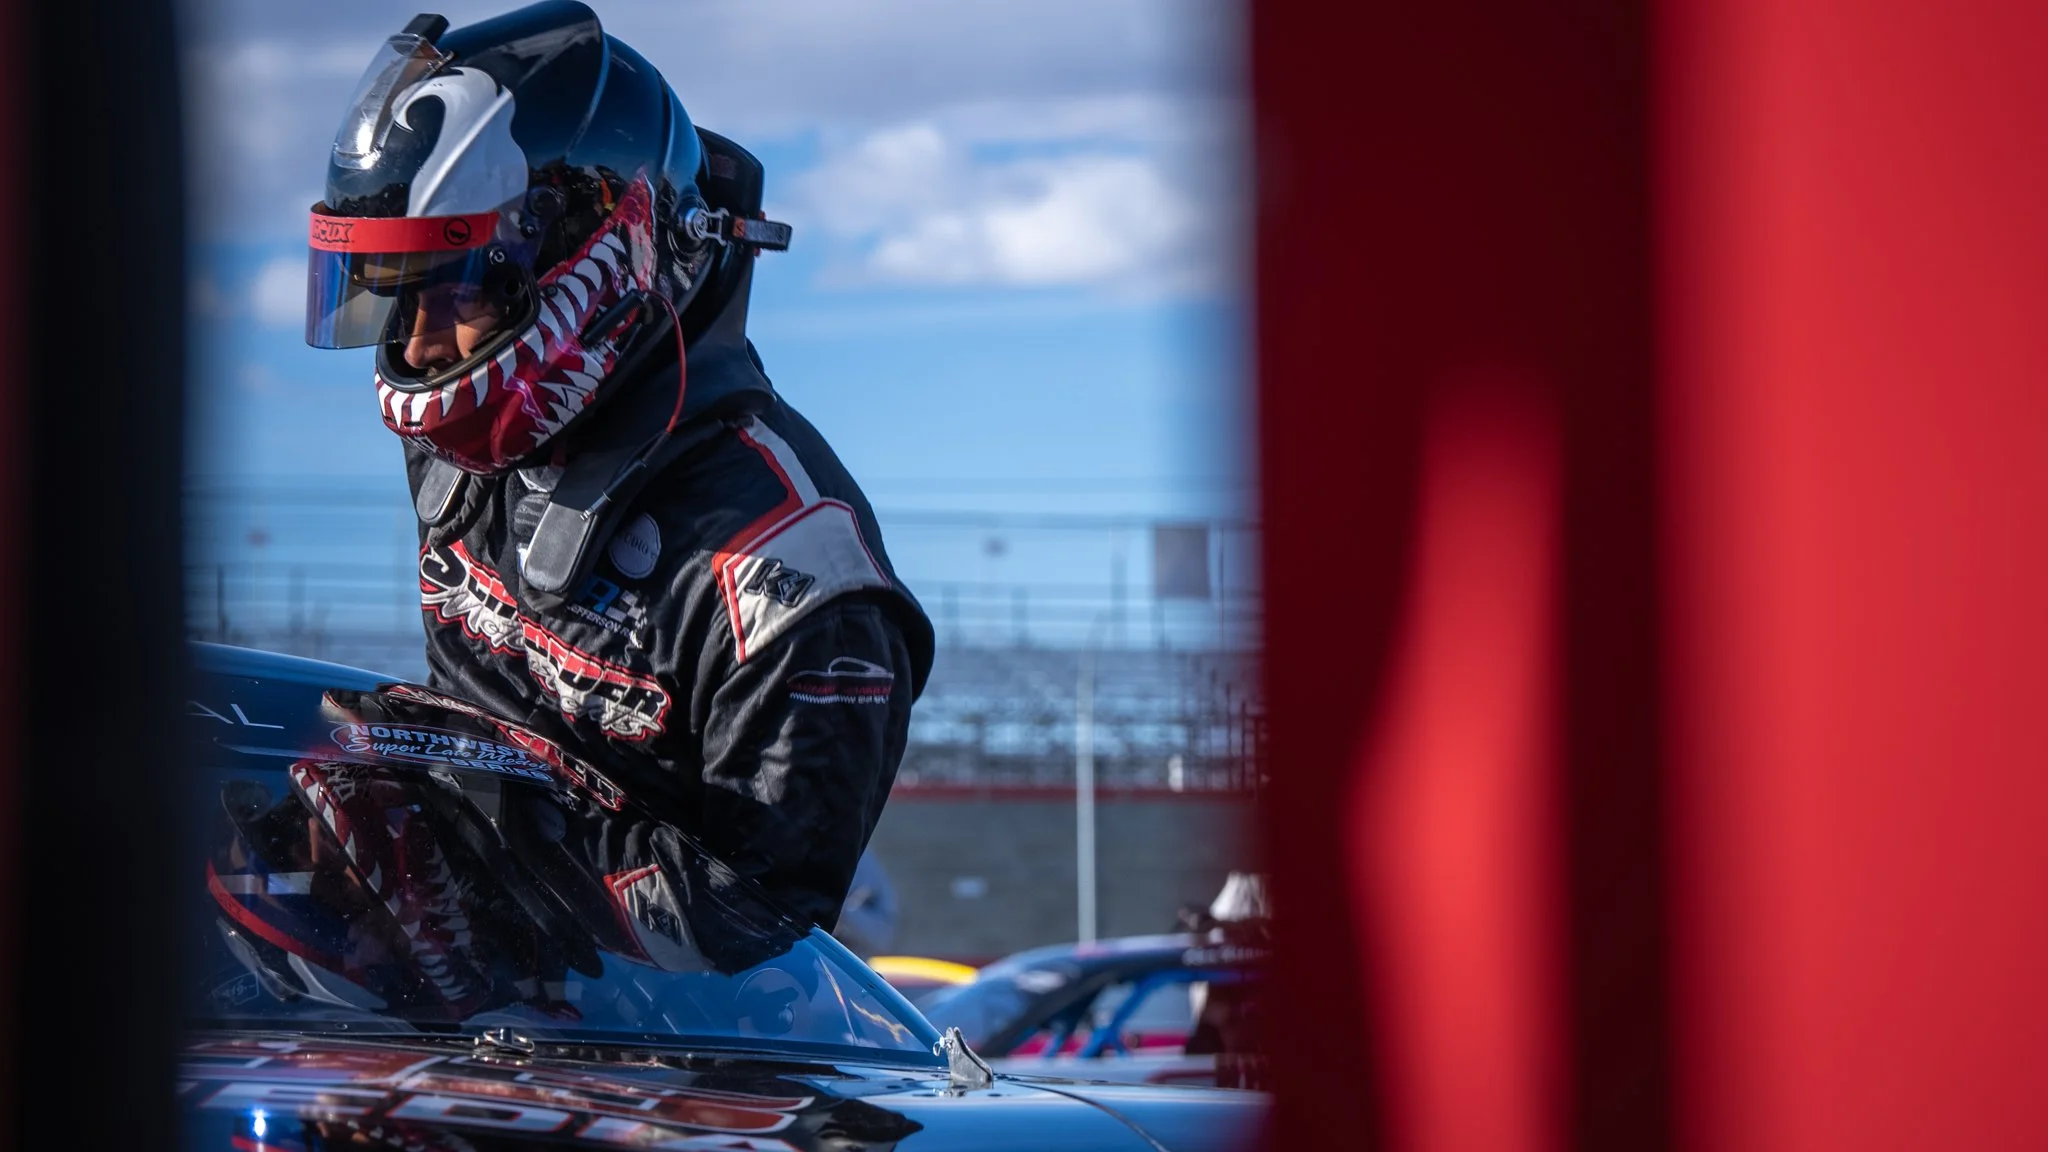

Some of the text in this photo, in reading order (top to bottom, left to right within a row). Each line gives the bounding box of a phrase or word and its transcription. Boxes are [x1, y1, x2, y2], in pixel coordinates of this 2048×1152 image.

[346, 735, 421, 754] Super
[425, 744, 470, 759] Late
[350, 724, 527, 760] NORTHWEST
[449, 758, 554, 782] SERIES
